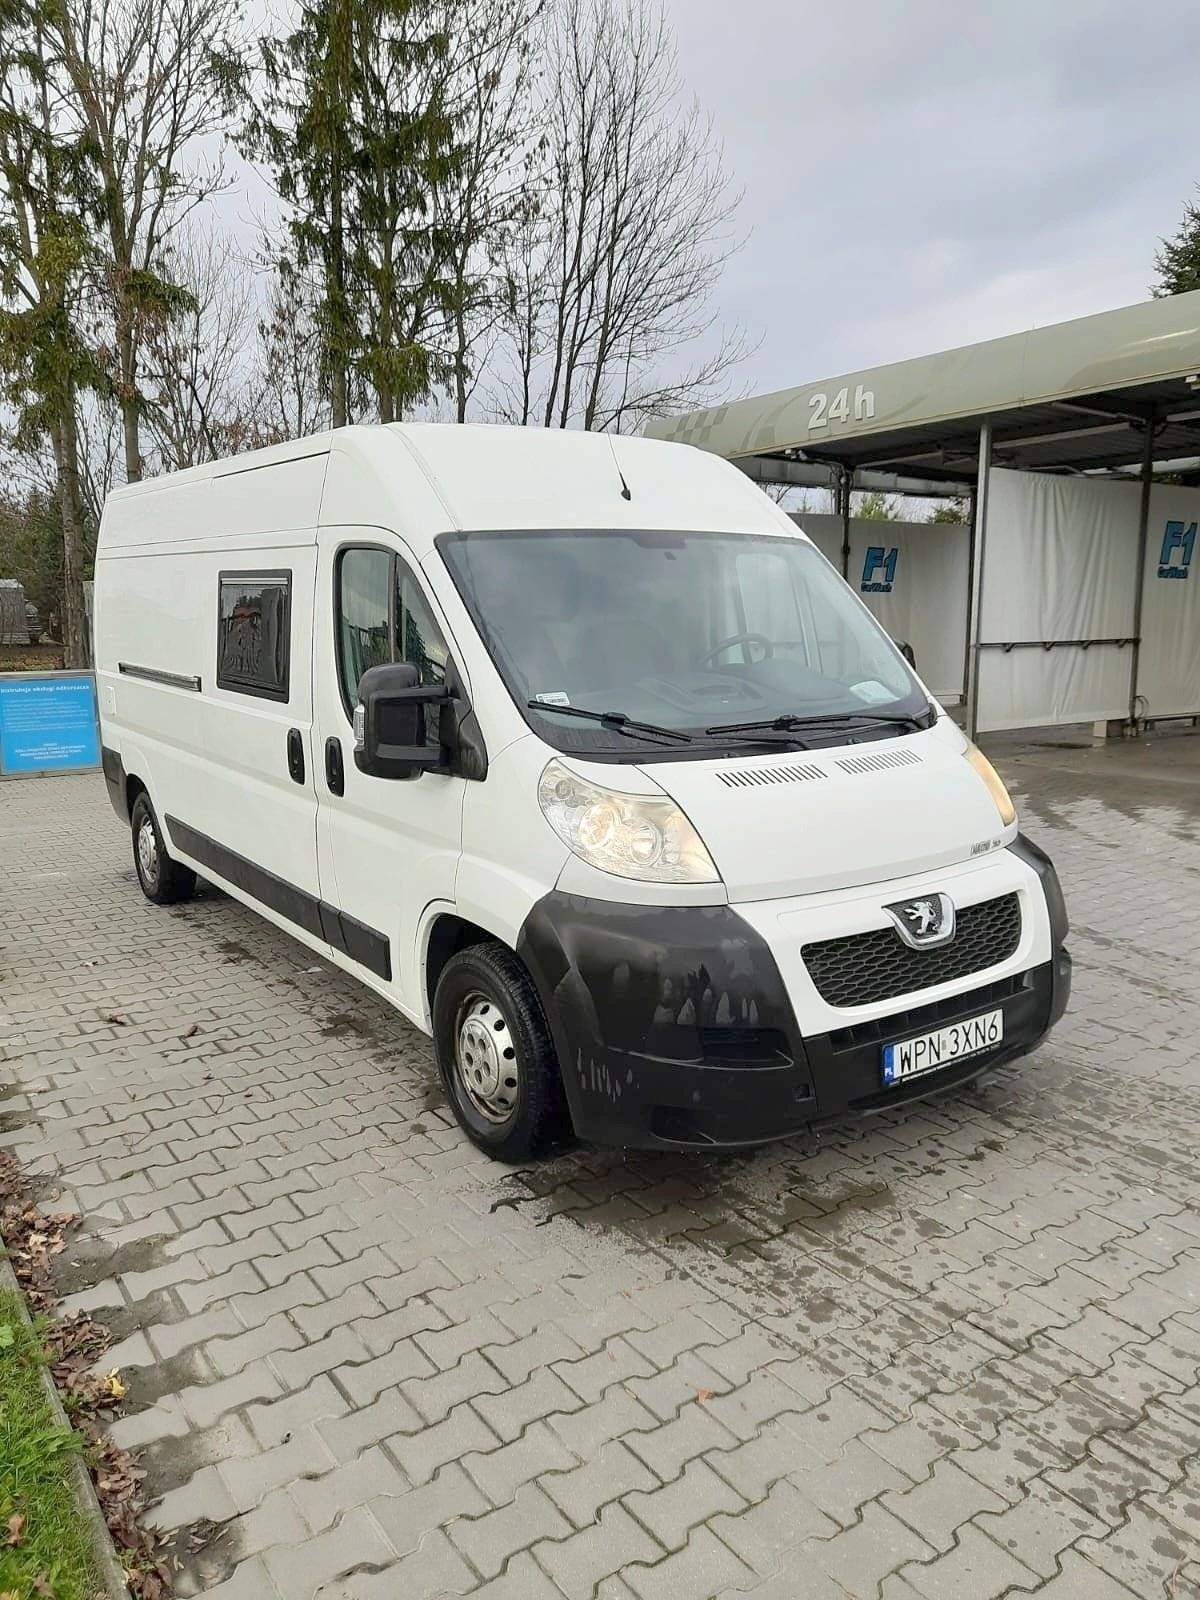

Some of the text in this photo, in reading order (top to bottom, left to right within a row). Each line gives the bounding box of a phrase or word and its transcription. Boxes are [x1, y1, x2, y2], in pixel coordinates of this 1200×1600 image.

[807, 384, 875, 430] 24h
[862, 547, 899, 582] F1
[1159, 521, 1198, 566] F1
[900, 1033, 941, 1074] WPN
[949, 1014, 998, 1056] 3XN6
